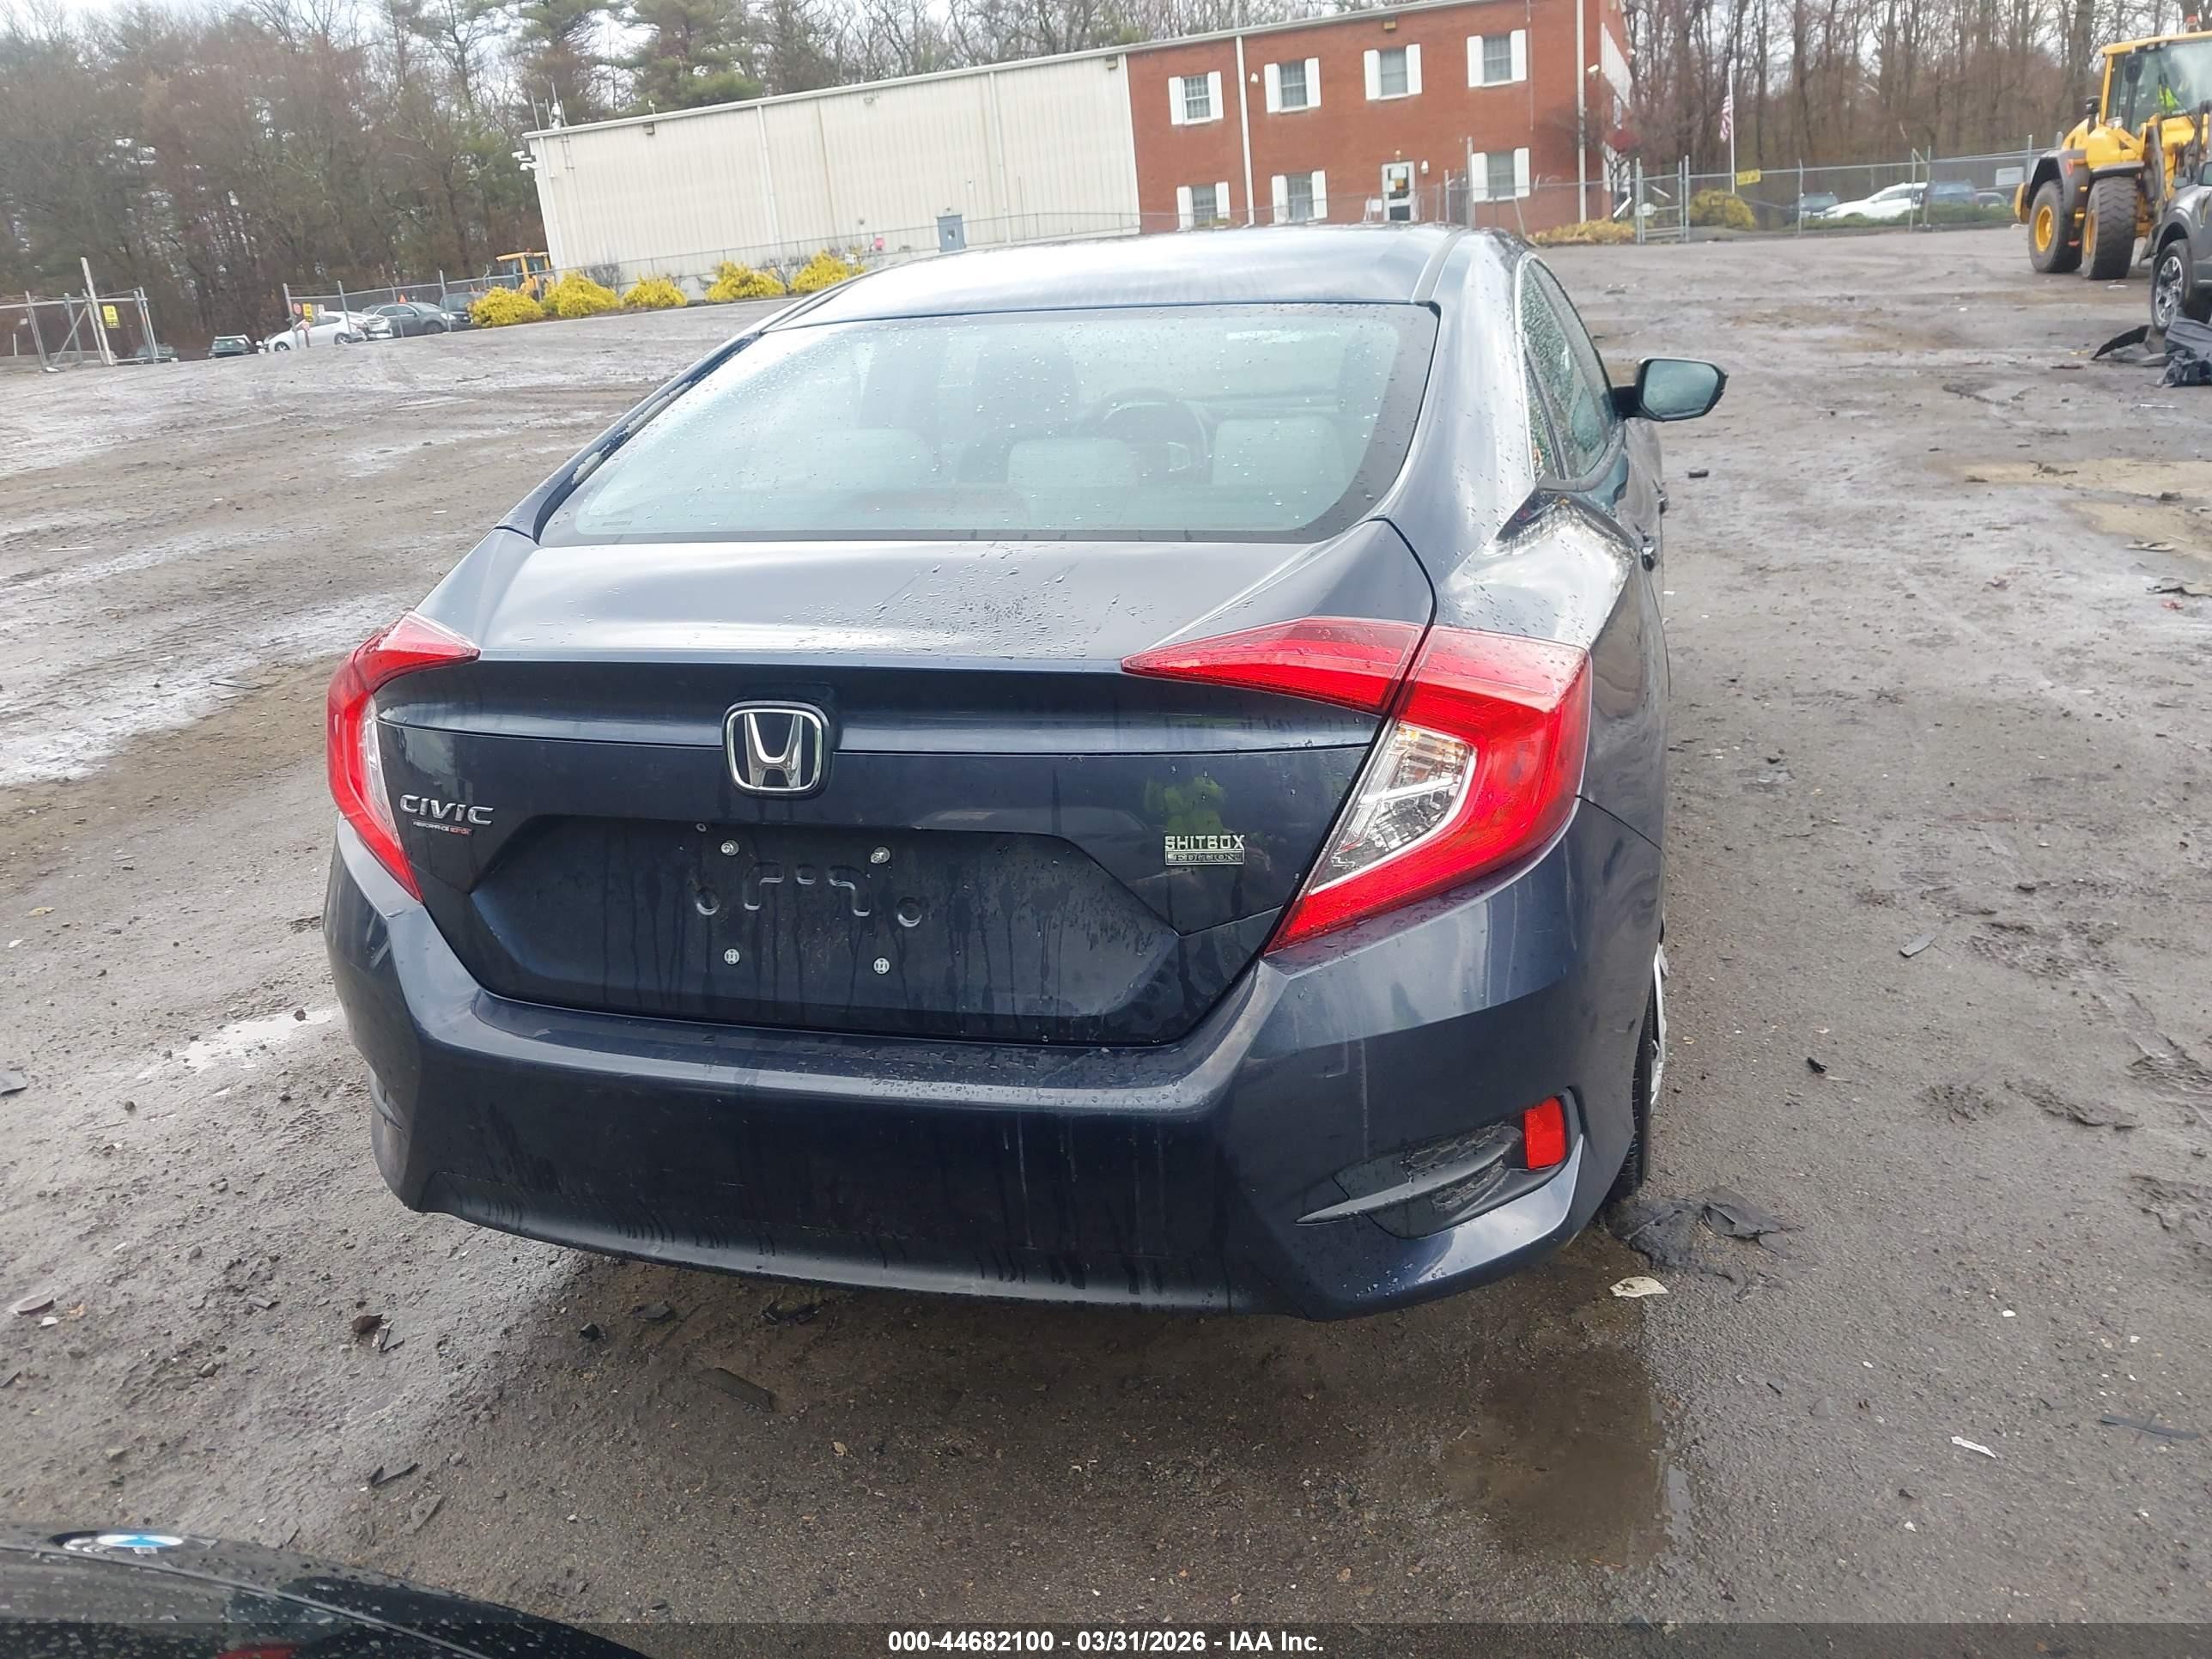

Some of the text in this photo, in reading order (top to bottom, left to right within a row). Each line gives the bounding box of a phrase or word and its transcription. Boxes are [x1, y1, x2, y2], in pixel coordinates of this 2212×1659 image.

[399, 793, 495, 825] CIVIC
[1164, 835, 1245, 849] SHITBOX
[1175, 854, 1237, 862] EDITION
